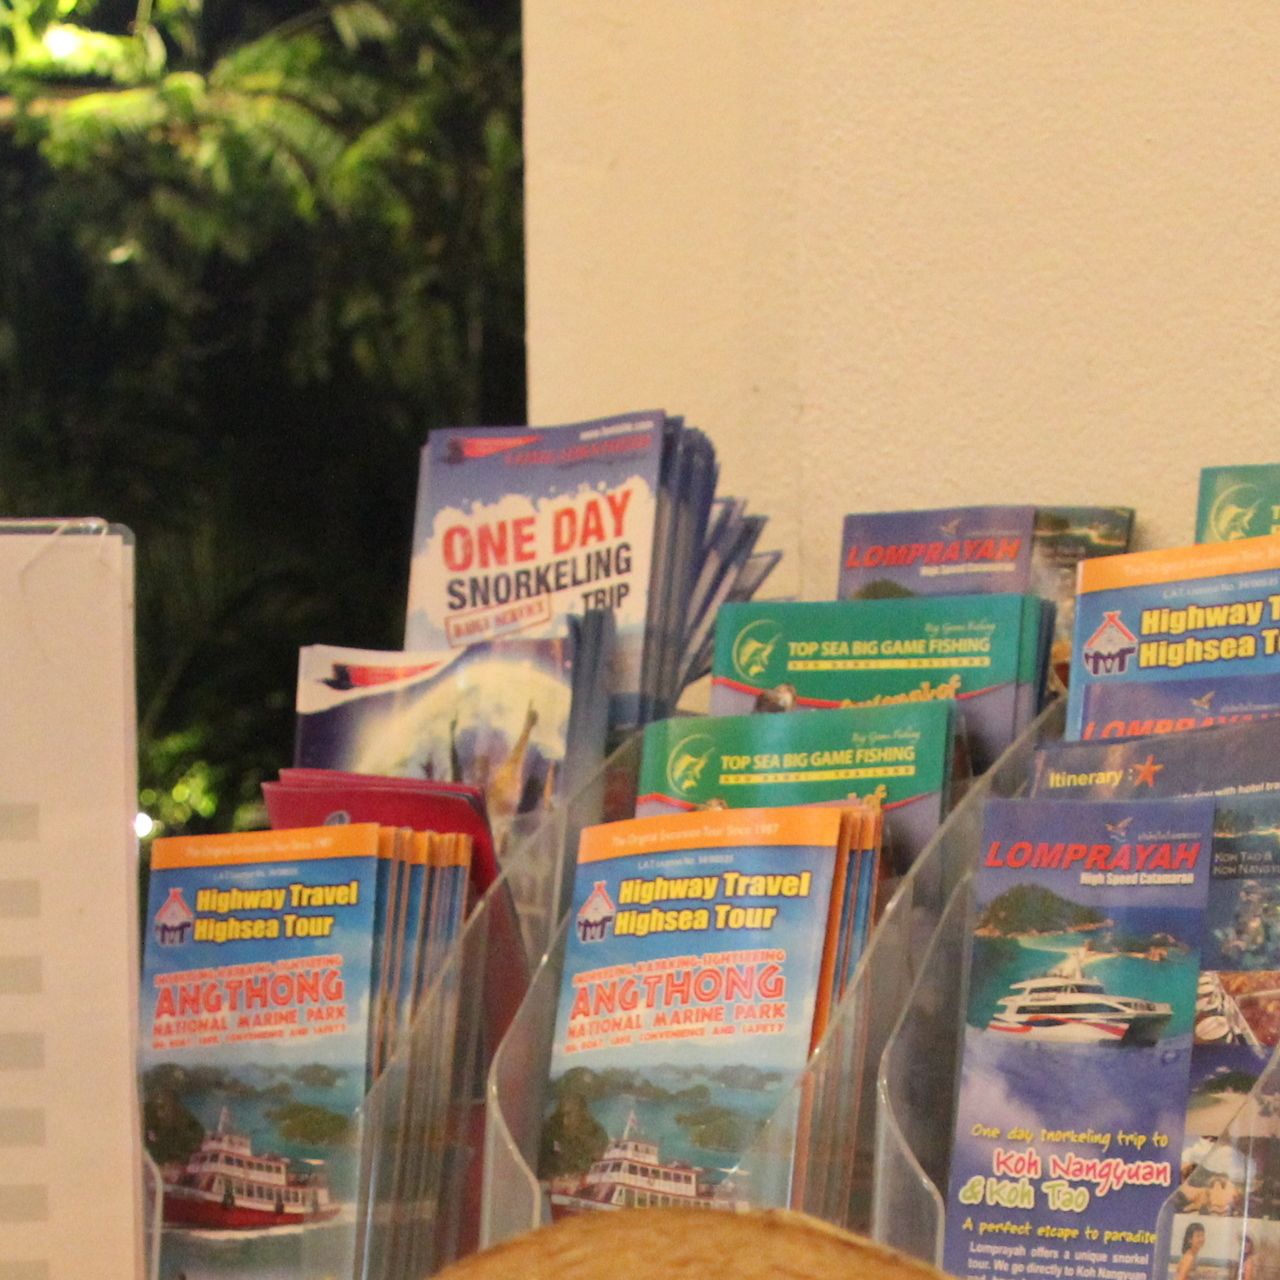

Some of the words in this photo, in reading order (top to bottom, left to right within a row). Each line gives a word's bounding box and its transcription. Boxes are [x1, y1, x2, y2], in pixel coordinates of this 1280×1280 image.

[442, 516, 537, 573] ONE
[553, 488, 633, 554] DAY
[846, 537, 1024, 569] LOMPRAYAH
[446, 542, 632, 611] SNORKELING
[581, 583, 630, 610] TRIP
[1140, 600, 1264, 635] Highway
[788, 641, 819, 657] TOP
[821, 641, 849, 657] SEA
[853, 640, 879, 656] BIG
[881, 639, 926, 655] GAME
[928, 637, 991, 654] FISHING
[1138, 634, 1257, 669] Highsea
[1049, 769, 1123, 789] Itinerary
[984, 841, 1201, 871] LOMPRAYAH
[619, 875, 719, 904] Highway
[723, 871, 812, 899] Travel
[1080, 872, 1104, 886] High
[1106, 872, 1137, 887] Speed
[196, 887, 286, 914] Highway
[289, 881, 360, 907] Travel
[193, 916, 280, 943] Highsea
[283, 913, 335, 939] Tour
[614, 907, 710, 936] Highsea
[714, 904, 778, 930] Tour
[154, 969, 345, 1020] ANGTHONG
[568, 964, 788, 1022] ANGTHONG
[994, 1148, 1041, 1178] Koh
[1049, 1153, 1171, 1197] Nangyuan
[959, 1175, 986, 1204] &
[986, 1178, 1034, 1209] Koh
[1041, 1180, 1090, 1212] Tao
